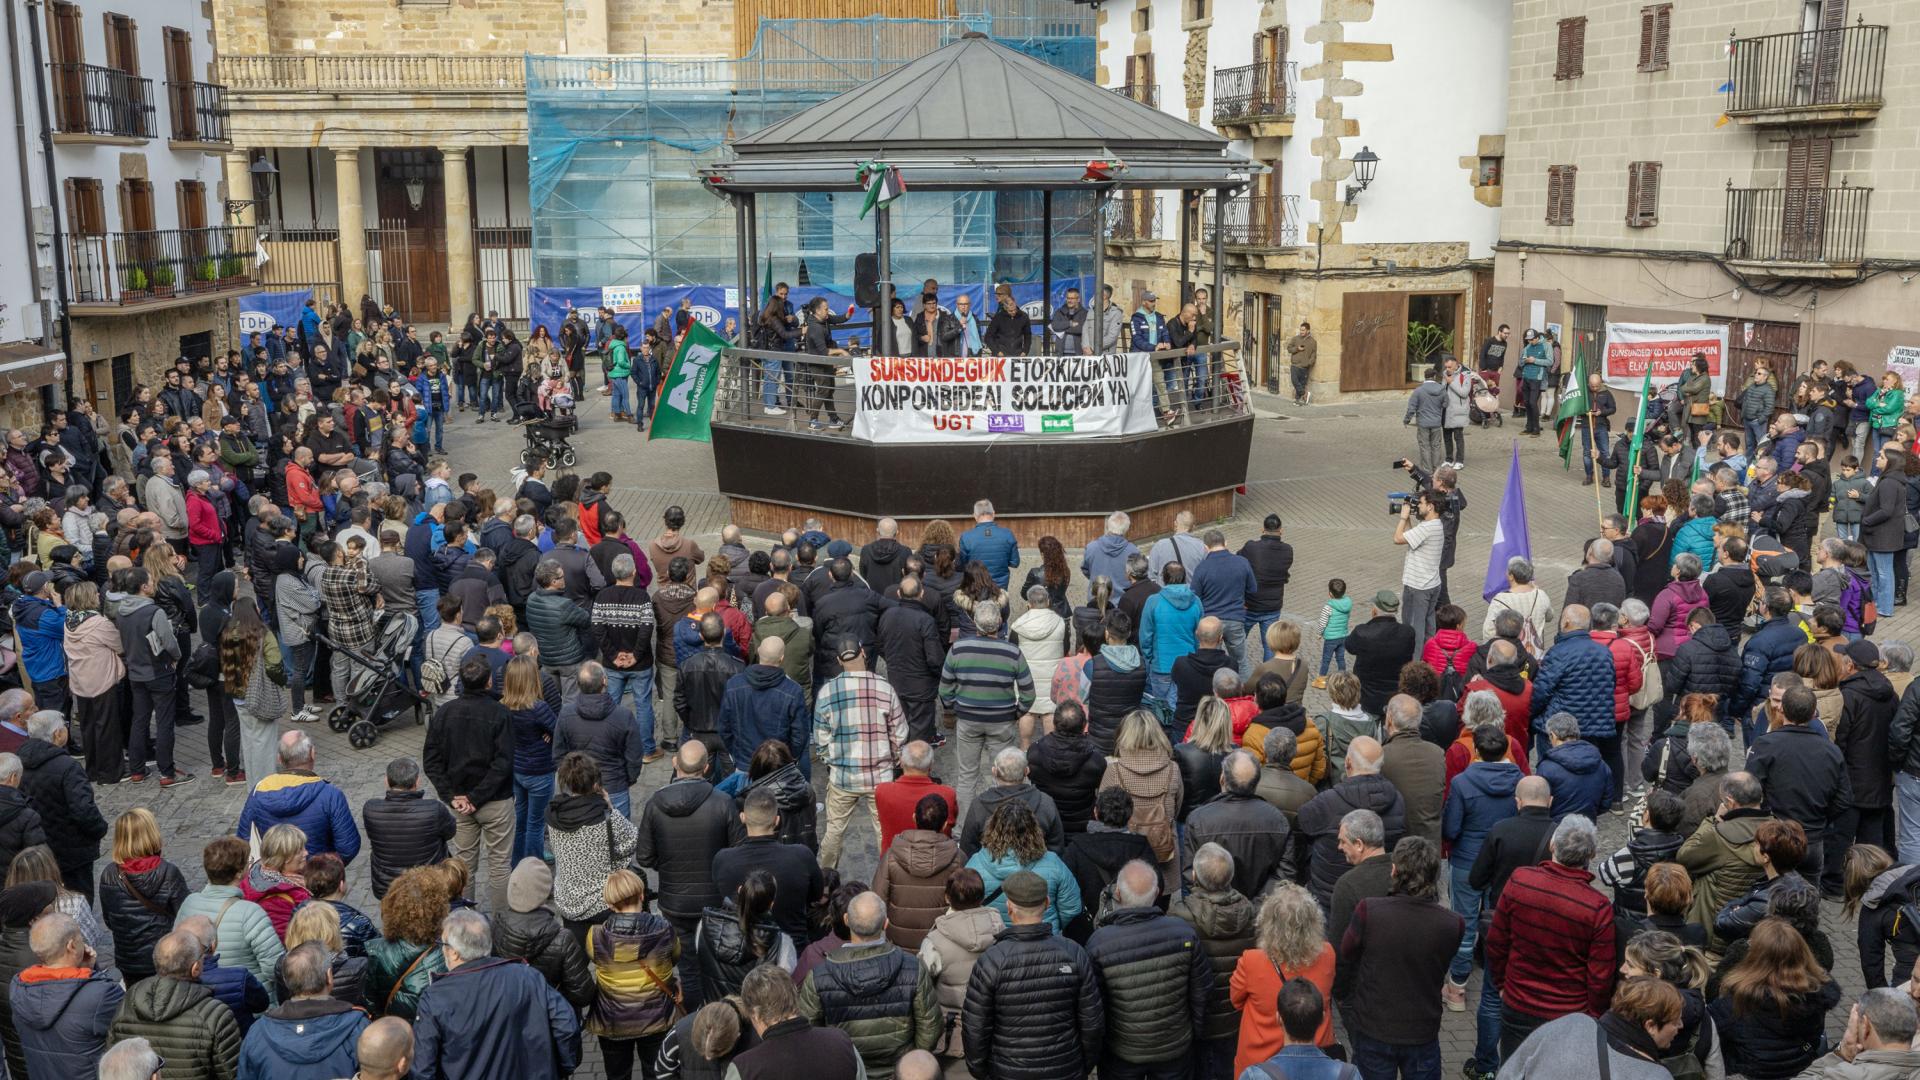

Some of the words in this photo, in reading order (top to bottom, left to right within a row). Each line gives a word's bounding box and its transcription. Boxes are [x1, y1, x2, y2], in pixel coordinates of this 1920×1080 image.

[240, 317, 267, 329] TDH
[870, 357, 1007, 383] SUNSUNDEGUIK
[1010, 354, 1112, 383] ETORKIZUNA
[1112, 354, 1128, 378] DU
[932, 414, 974, 431] UGT
